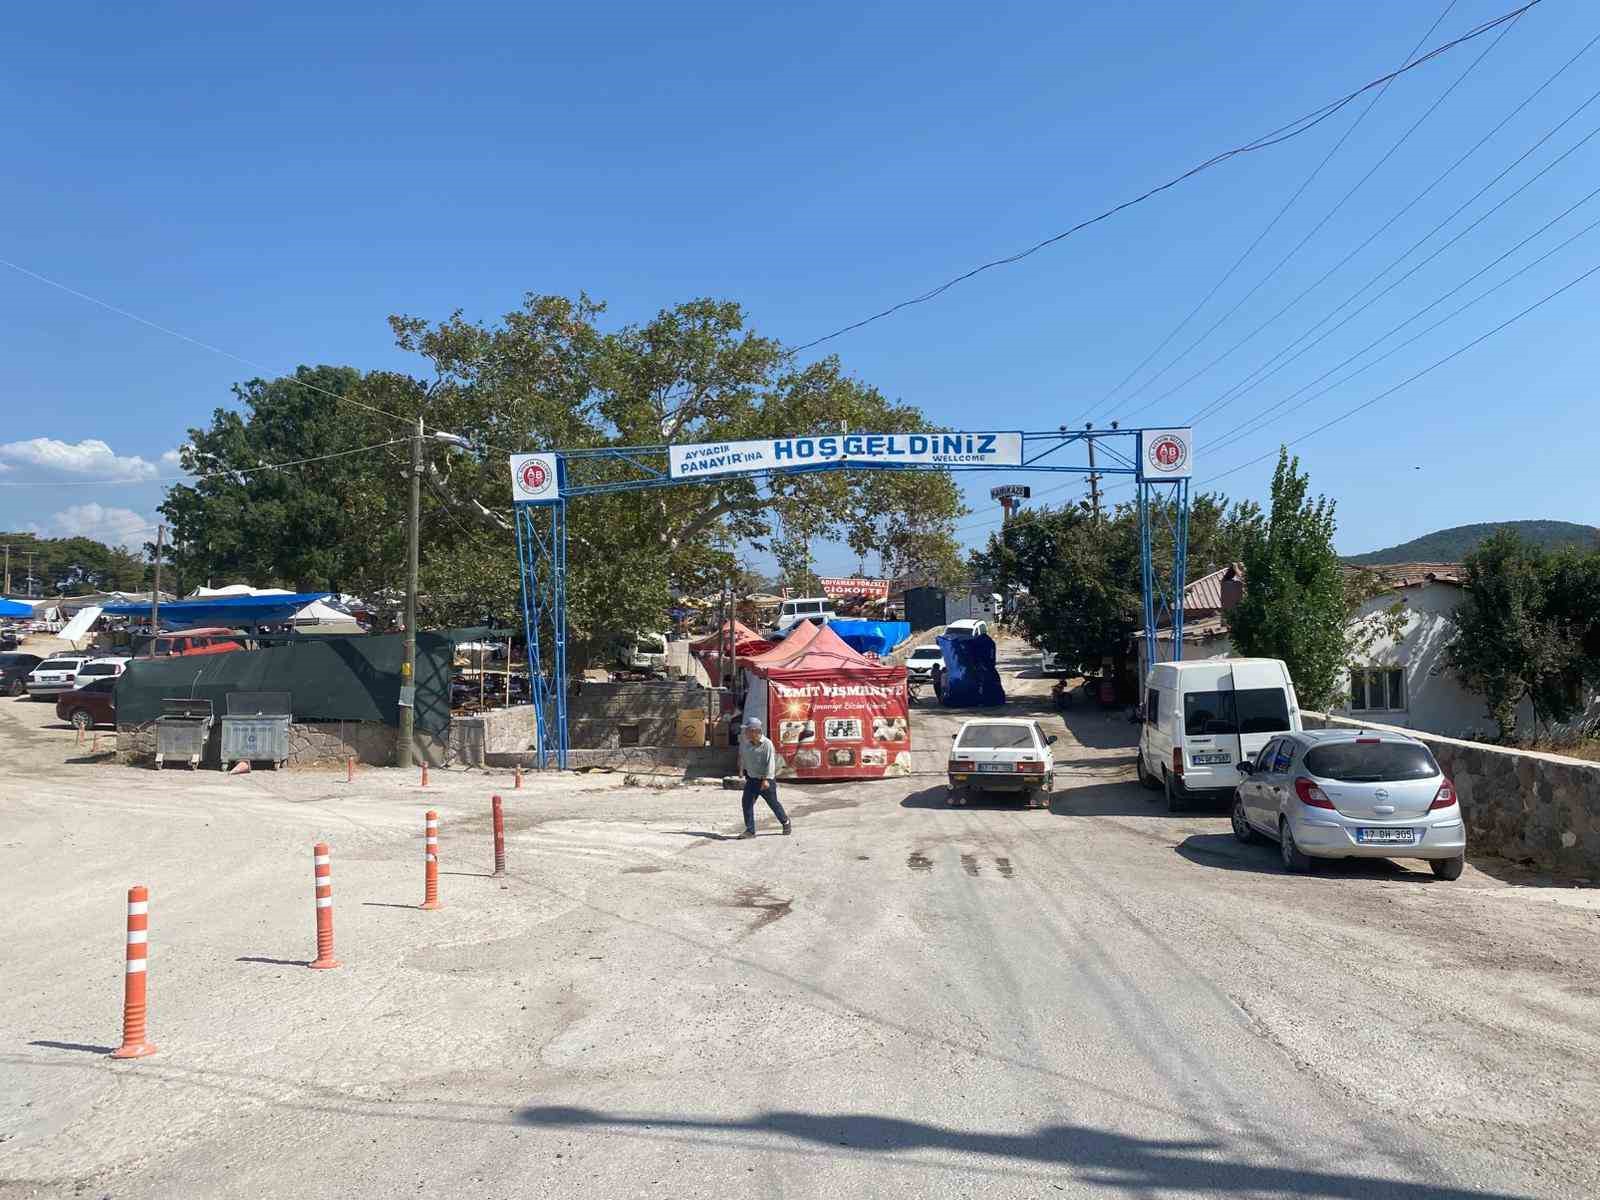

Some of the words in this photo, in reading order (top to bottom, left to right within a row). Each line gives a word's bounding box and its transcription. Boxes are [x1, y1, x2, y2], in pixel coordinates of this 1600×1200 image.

[932, 454, 985, 462] WELLCOME
[1364, 830, 1375, 839] 17
[1395, 830, 1412, 839] 305
